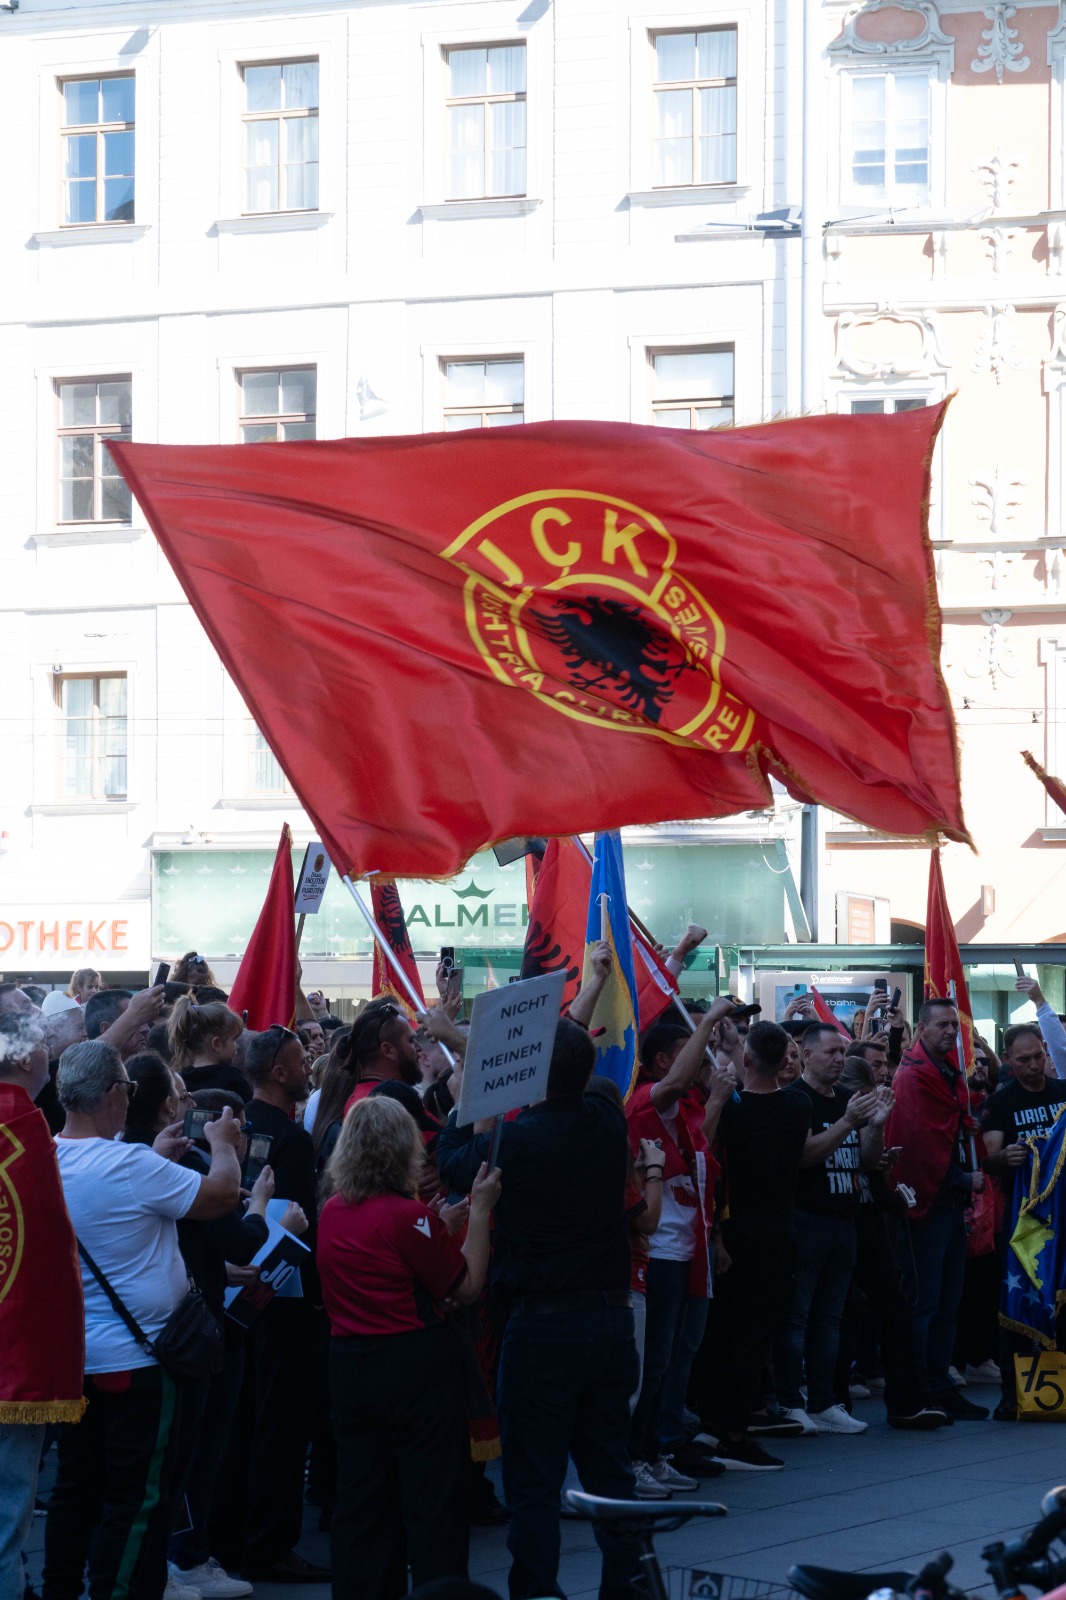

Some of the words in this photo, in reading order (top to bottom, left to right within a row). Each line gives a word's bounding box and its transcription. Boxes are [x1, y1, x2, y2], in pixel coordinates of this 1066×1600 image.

[500, 994, 549, 1019] NICHT
[507, 1024, 524, 1040] IN
[481, 1041, 542, 1071] MEINEM
[483, 1065, 537, 1093] NAMEN
[1013, 1106, 1049, 1126] LIRIA
[826, 1172, 854, 1194] TIM
[259, 1258, 297, 1290] JO
